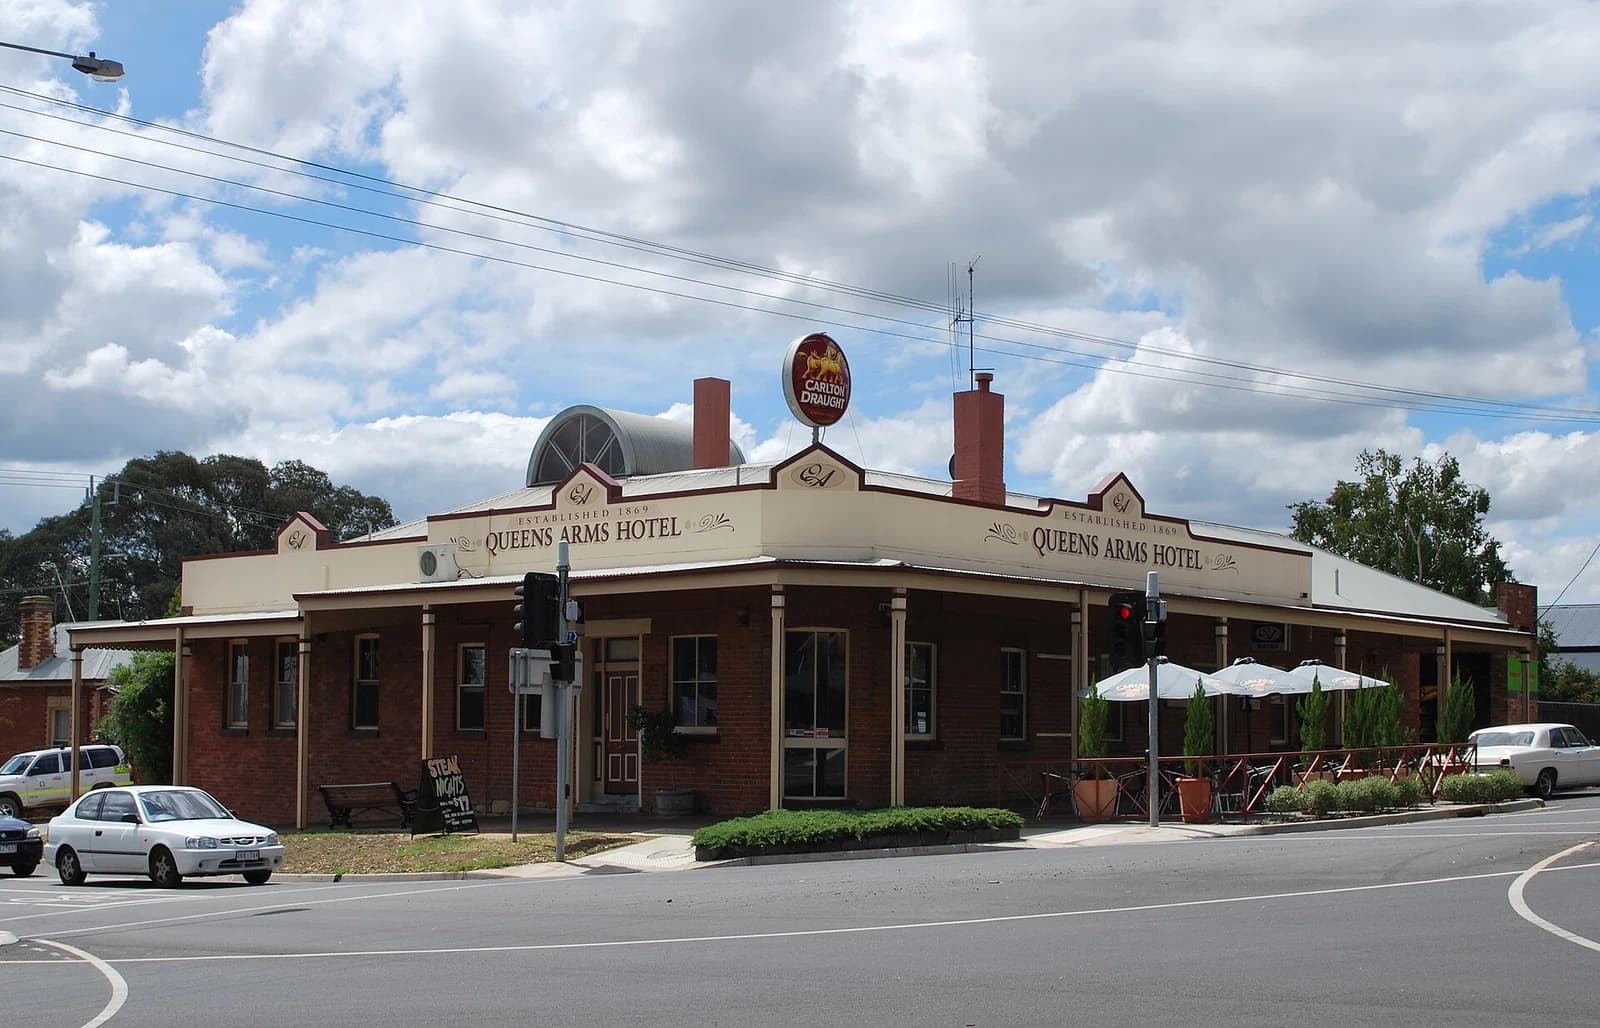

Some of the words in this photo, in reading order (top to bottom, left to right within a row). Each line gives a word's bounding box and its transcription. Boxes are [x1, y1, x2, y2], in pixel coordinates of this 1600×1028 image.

[800, 390, 846, 409] DRAUGHT
[805, 379, 845, 398] CARLTON
[518, 509, 610, 526] ESTABLISHED
[619, 505, 649, 516] 1869
[1064, 511, 1146, 531] ESTABLISHED
[1152, 524, 1177, 536] 1869
[485, 527, 553, 556] QUEENS
[560, 522, 610, 545] ARMS
[616, 516, 682, 540] HOTEL
[1033, 526, 1099, 557] QUEENS
[1104, 536, 1148, 564] ARMS
[1152, 543, 1203, 570] HOTEL
[427, 755, 462, 778] STEAK
